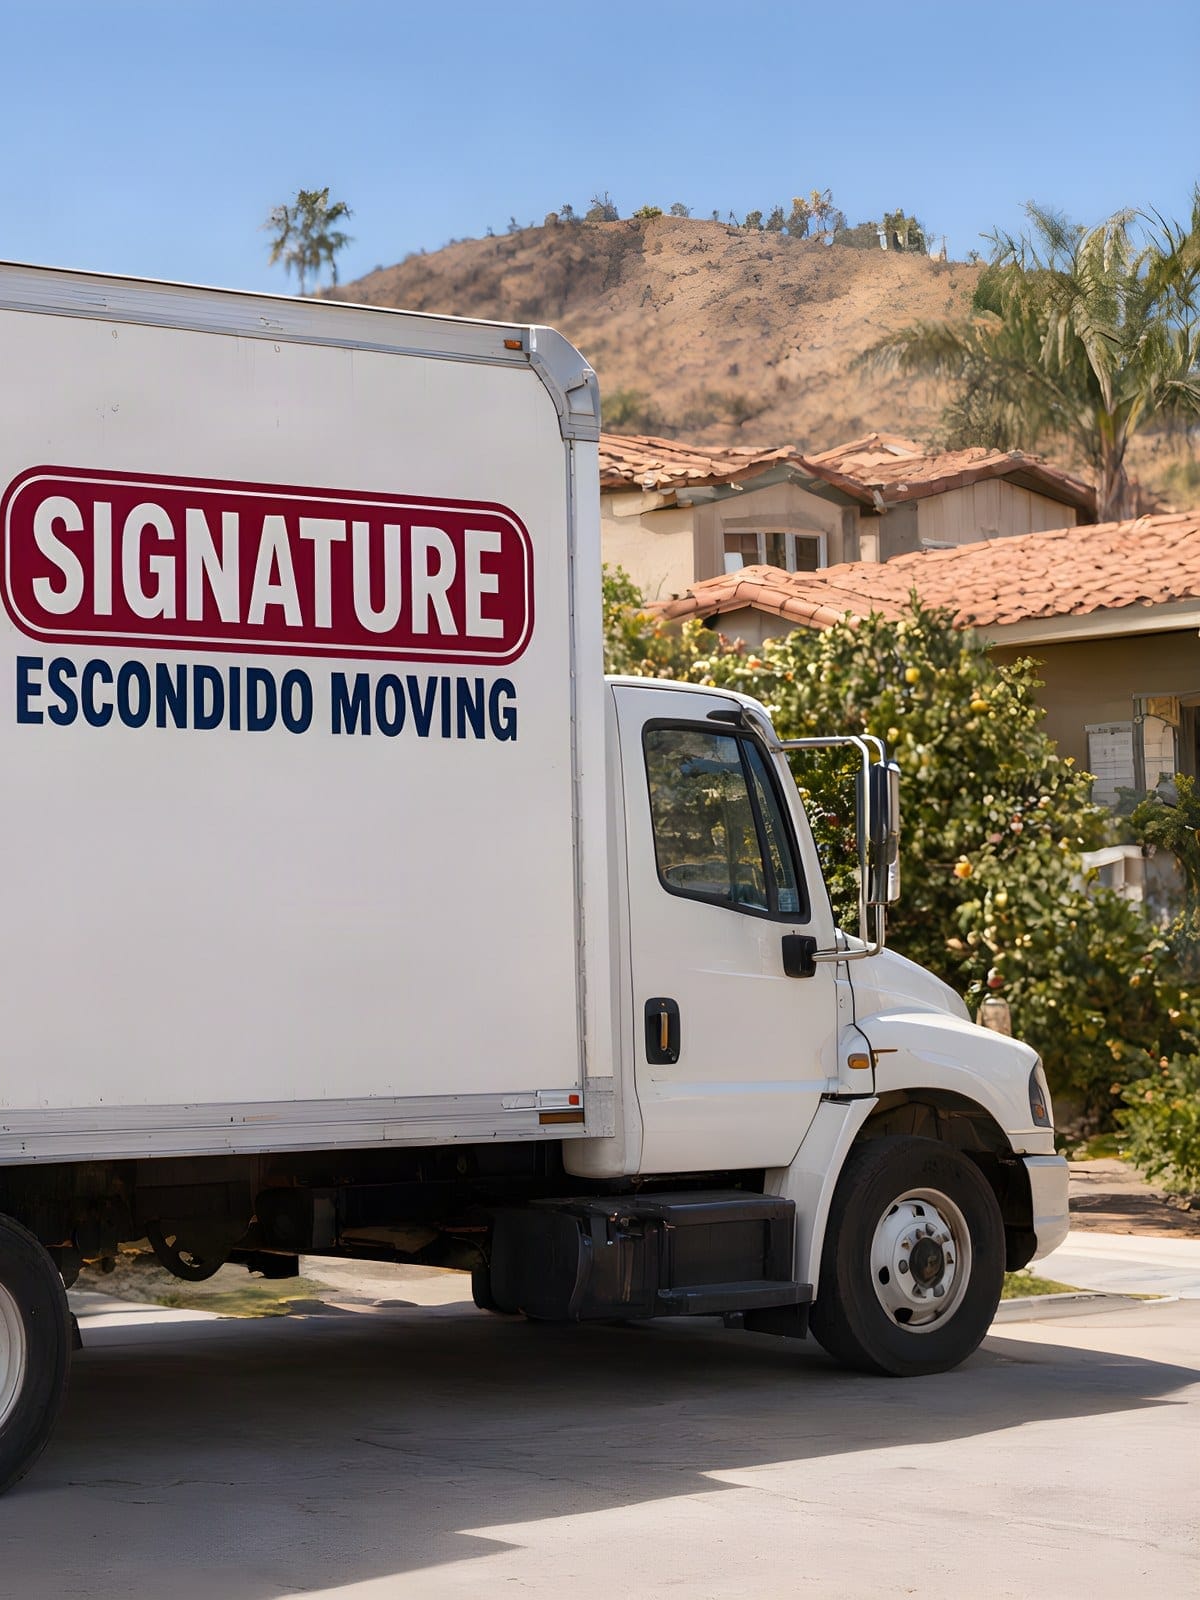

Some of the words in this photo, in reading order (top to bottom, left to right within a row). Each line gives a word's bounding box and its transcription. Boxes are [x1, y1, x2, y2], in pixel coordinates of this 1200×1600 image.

[32, 495, 504, 639] SIGNATURE
[16, 655, 314, 735] ESCONDIDO
[330, 671, 518, 742] MOVING
